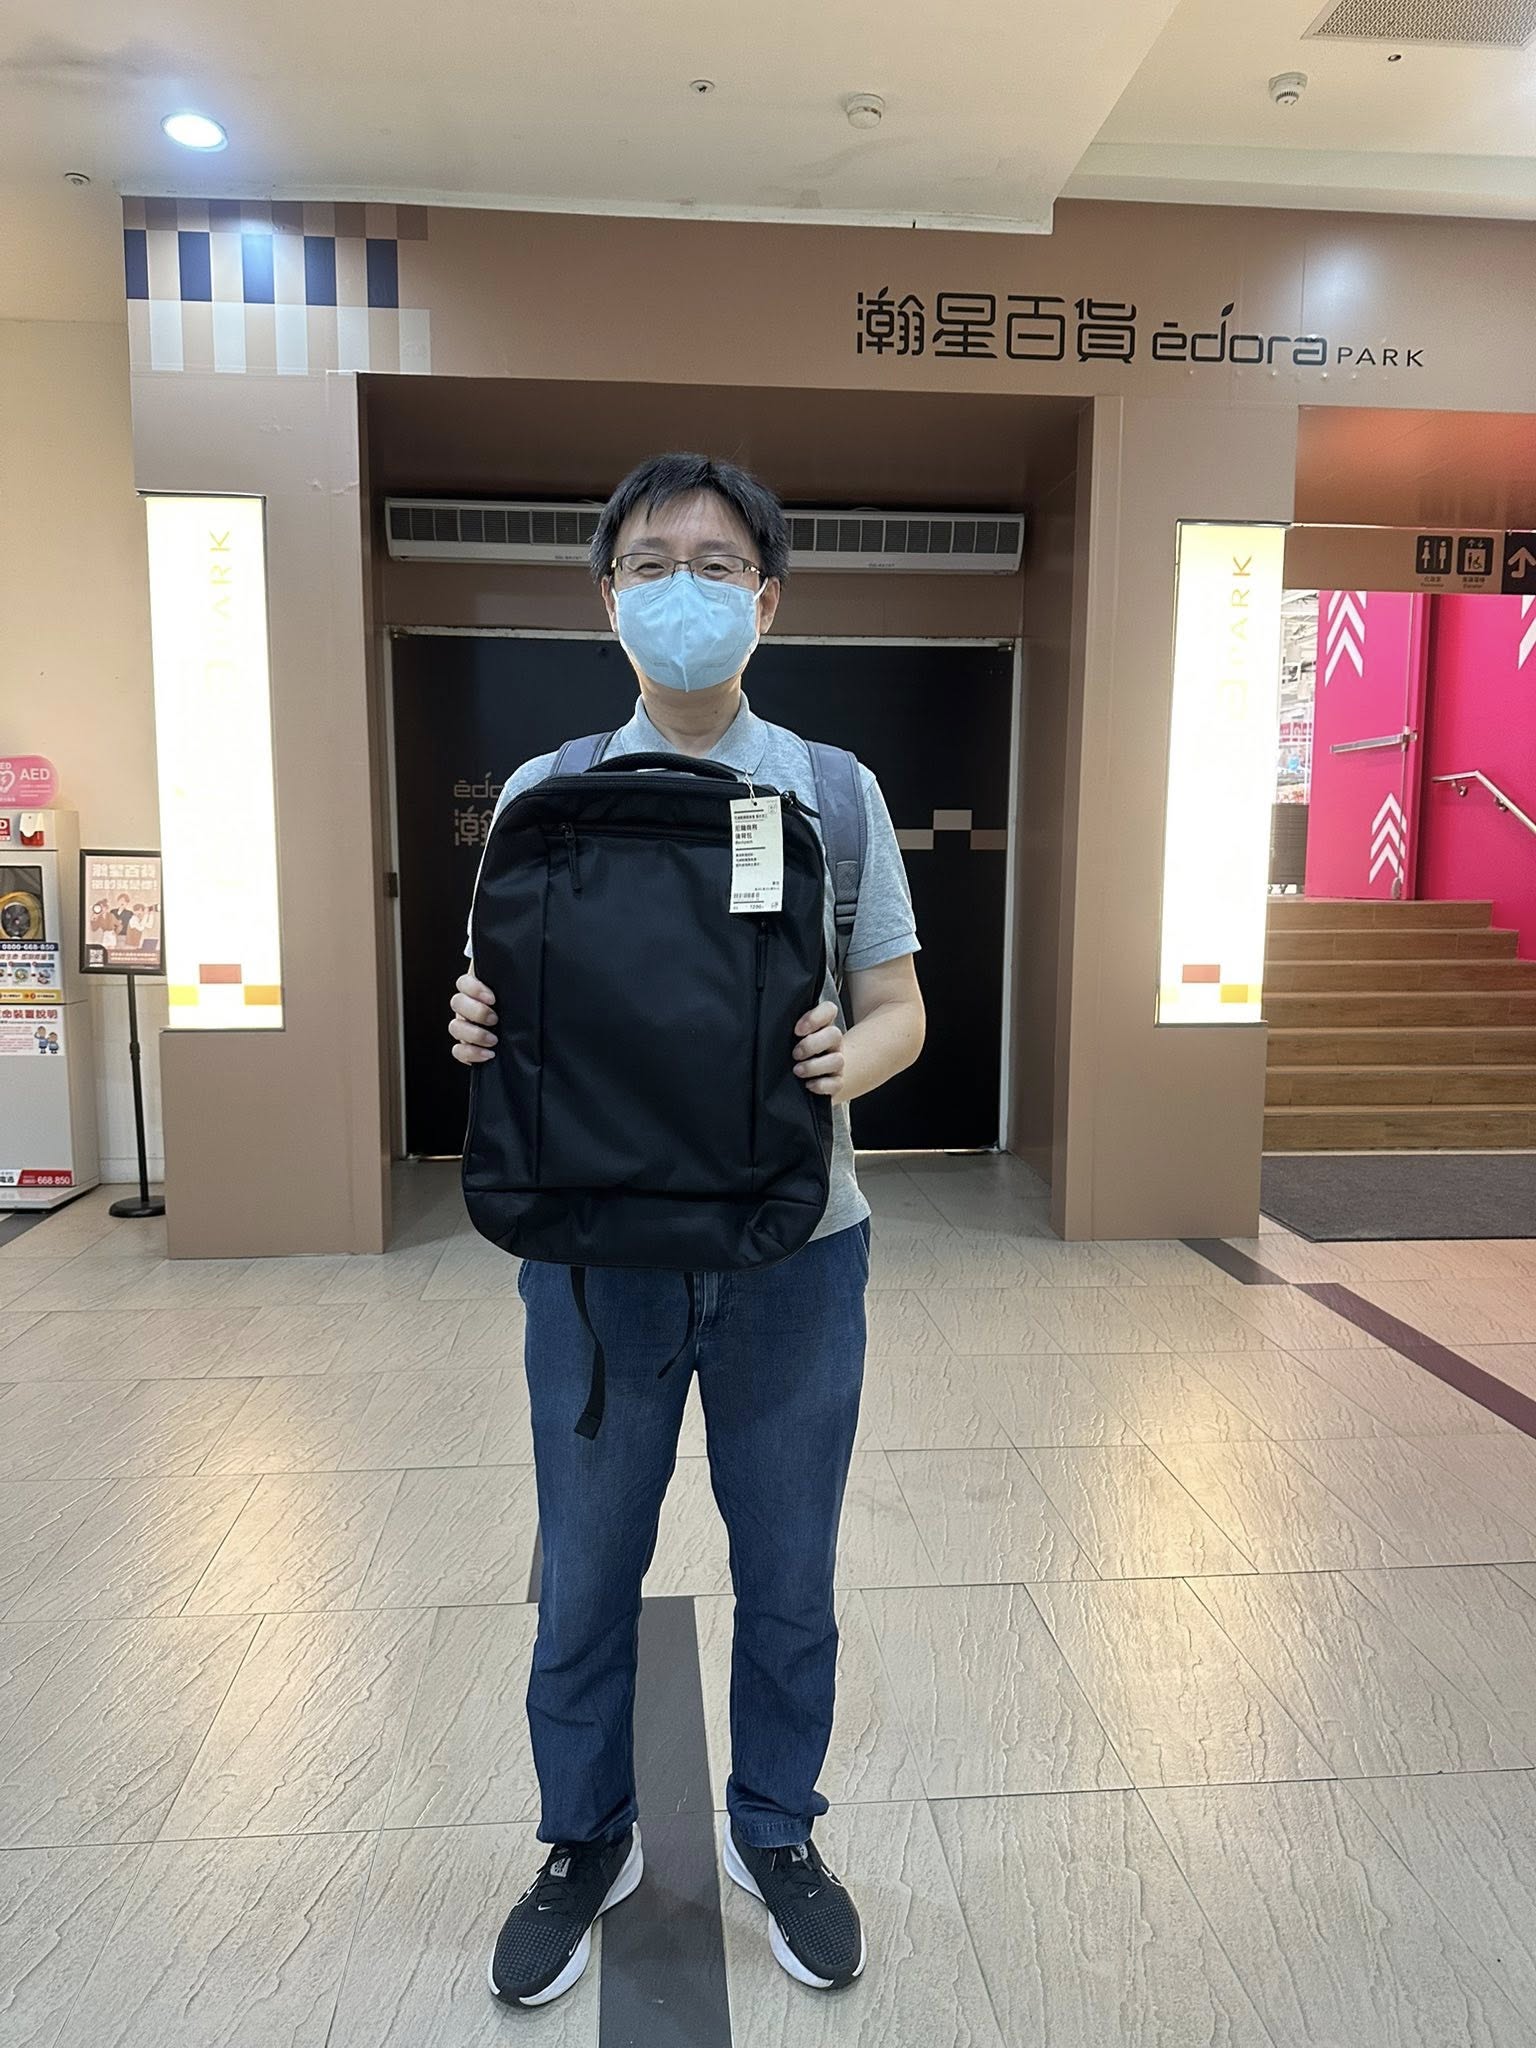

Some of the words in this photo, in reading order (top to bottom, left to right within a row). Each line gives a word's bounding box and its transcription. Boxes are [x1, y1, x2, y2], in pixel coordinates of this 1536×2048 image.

[856, 286, 1137, 365] 瀚星百貨
[1337, 347, 1424, 367] PARK
[20, 768, 50, 780] AED
